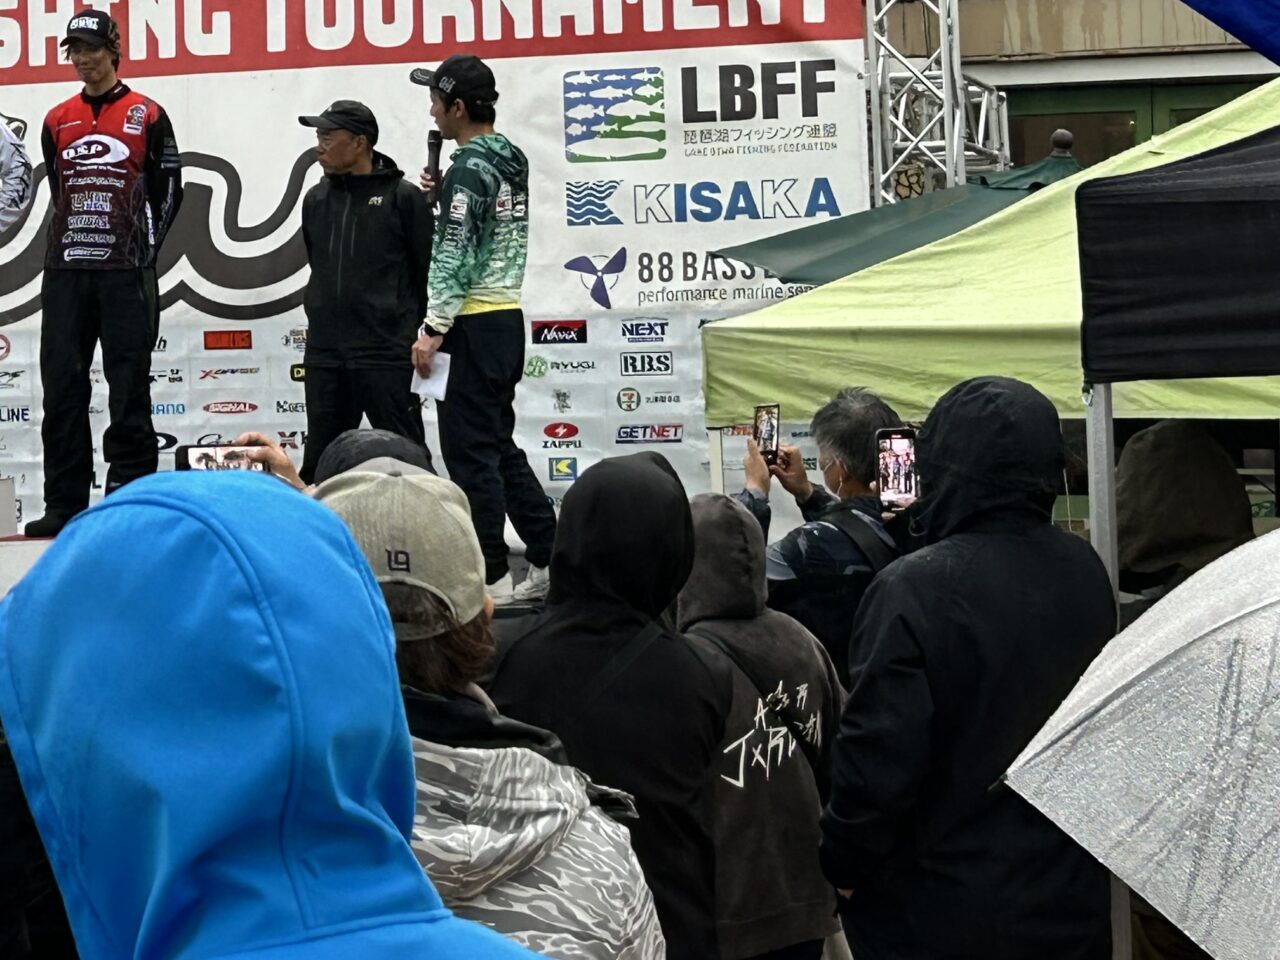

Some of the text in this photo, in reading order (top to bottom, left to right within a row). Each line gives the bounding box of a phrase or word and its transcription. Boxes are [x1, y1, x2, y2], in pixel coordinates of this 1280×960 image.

[681, 59, 836, 123] LBFF
[634, 177, 842, 225] KISAKA
[638, 251, 673, 283] 88
[638, 285, 728, 307] performance
[733, 283, 783, 300] marine
[621, 321, 670, 337] NEXT
[550, 360, 596, 370] RYUGI
[623, 353, 671, 374] RBS
[618, 424, 683, 439] GETNET
